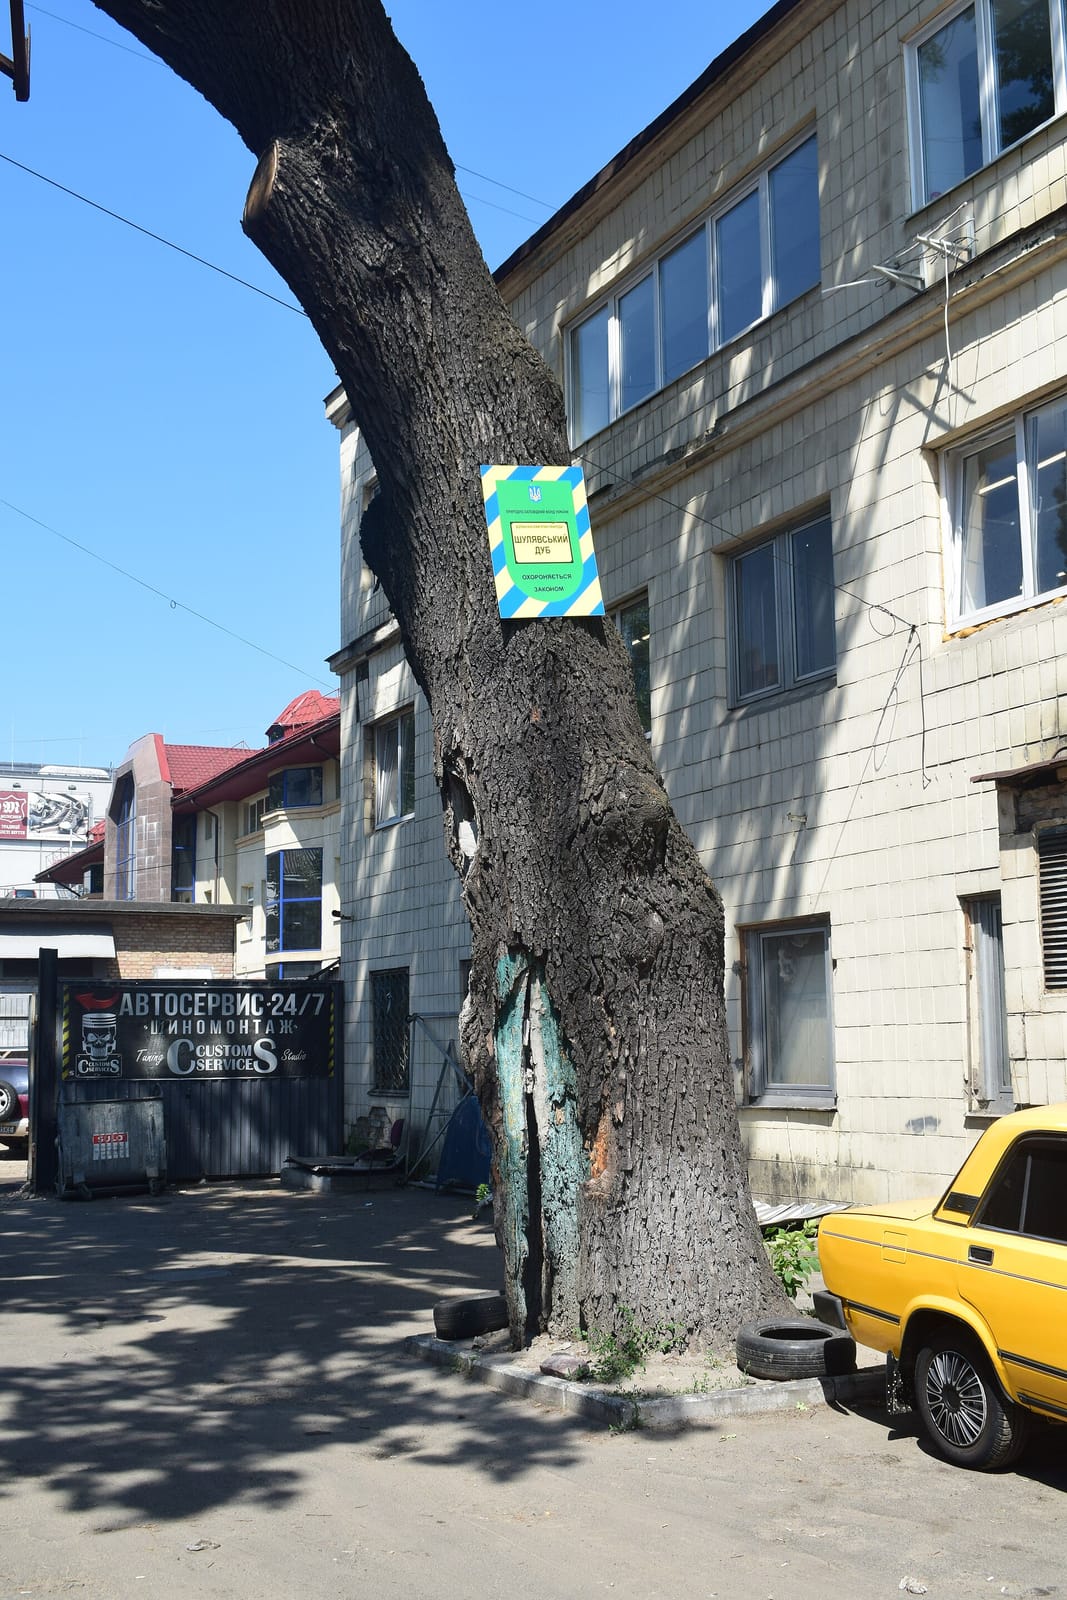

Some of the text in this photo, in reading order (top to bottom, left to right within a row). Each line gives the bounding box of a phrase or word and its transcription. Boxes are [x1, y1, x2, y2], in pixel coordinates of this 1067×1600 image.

[514, 534, 568, 544] ШУЛЯВСЬКИЙ
[535, 546, 551, 555] ДУБ
[136, 1048, 165, 1065] Tuning
[196, 1044, 252, 1057] CUSTOM
[280, 1048, 307, 1061] Studio
[196, 1058, 253, 1071] SERVICE
